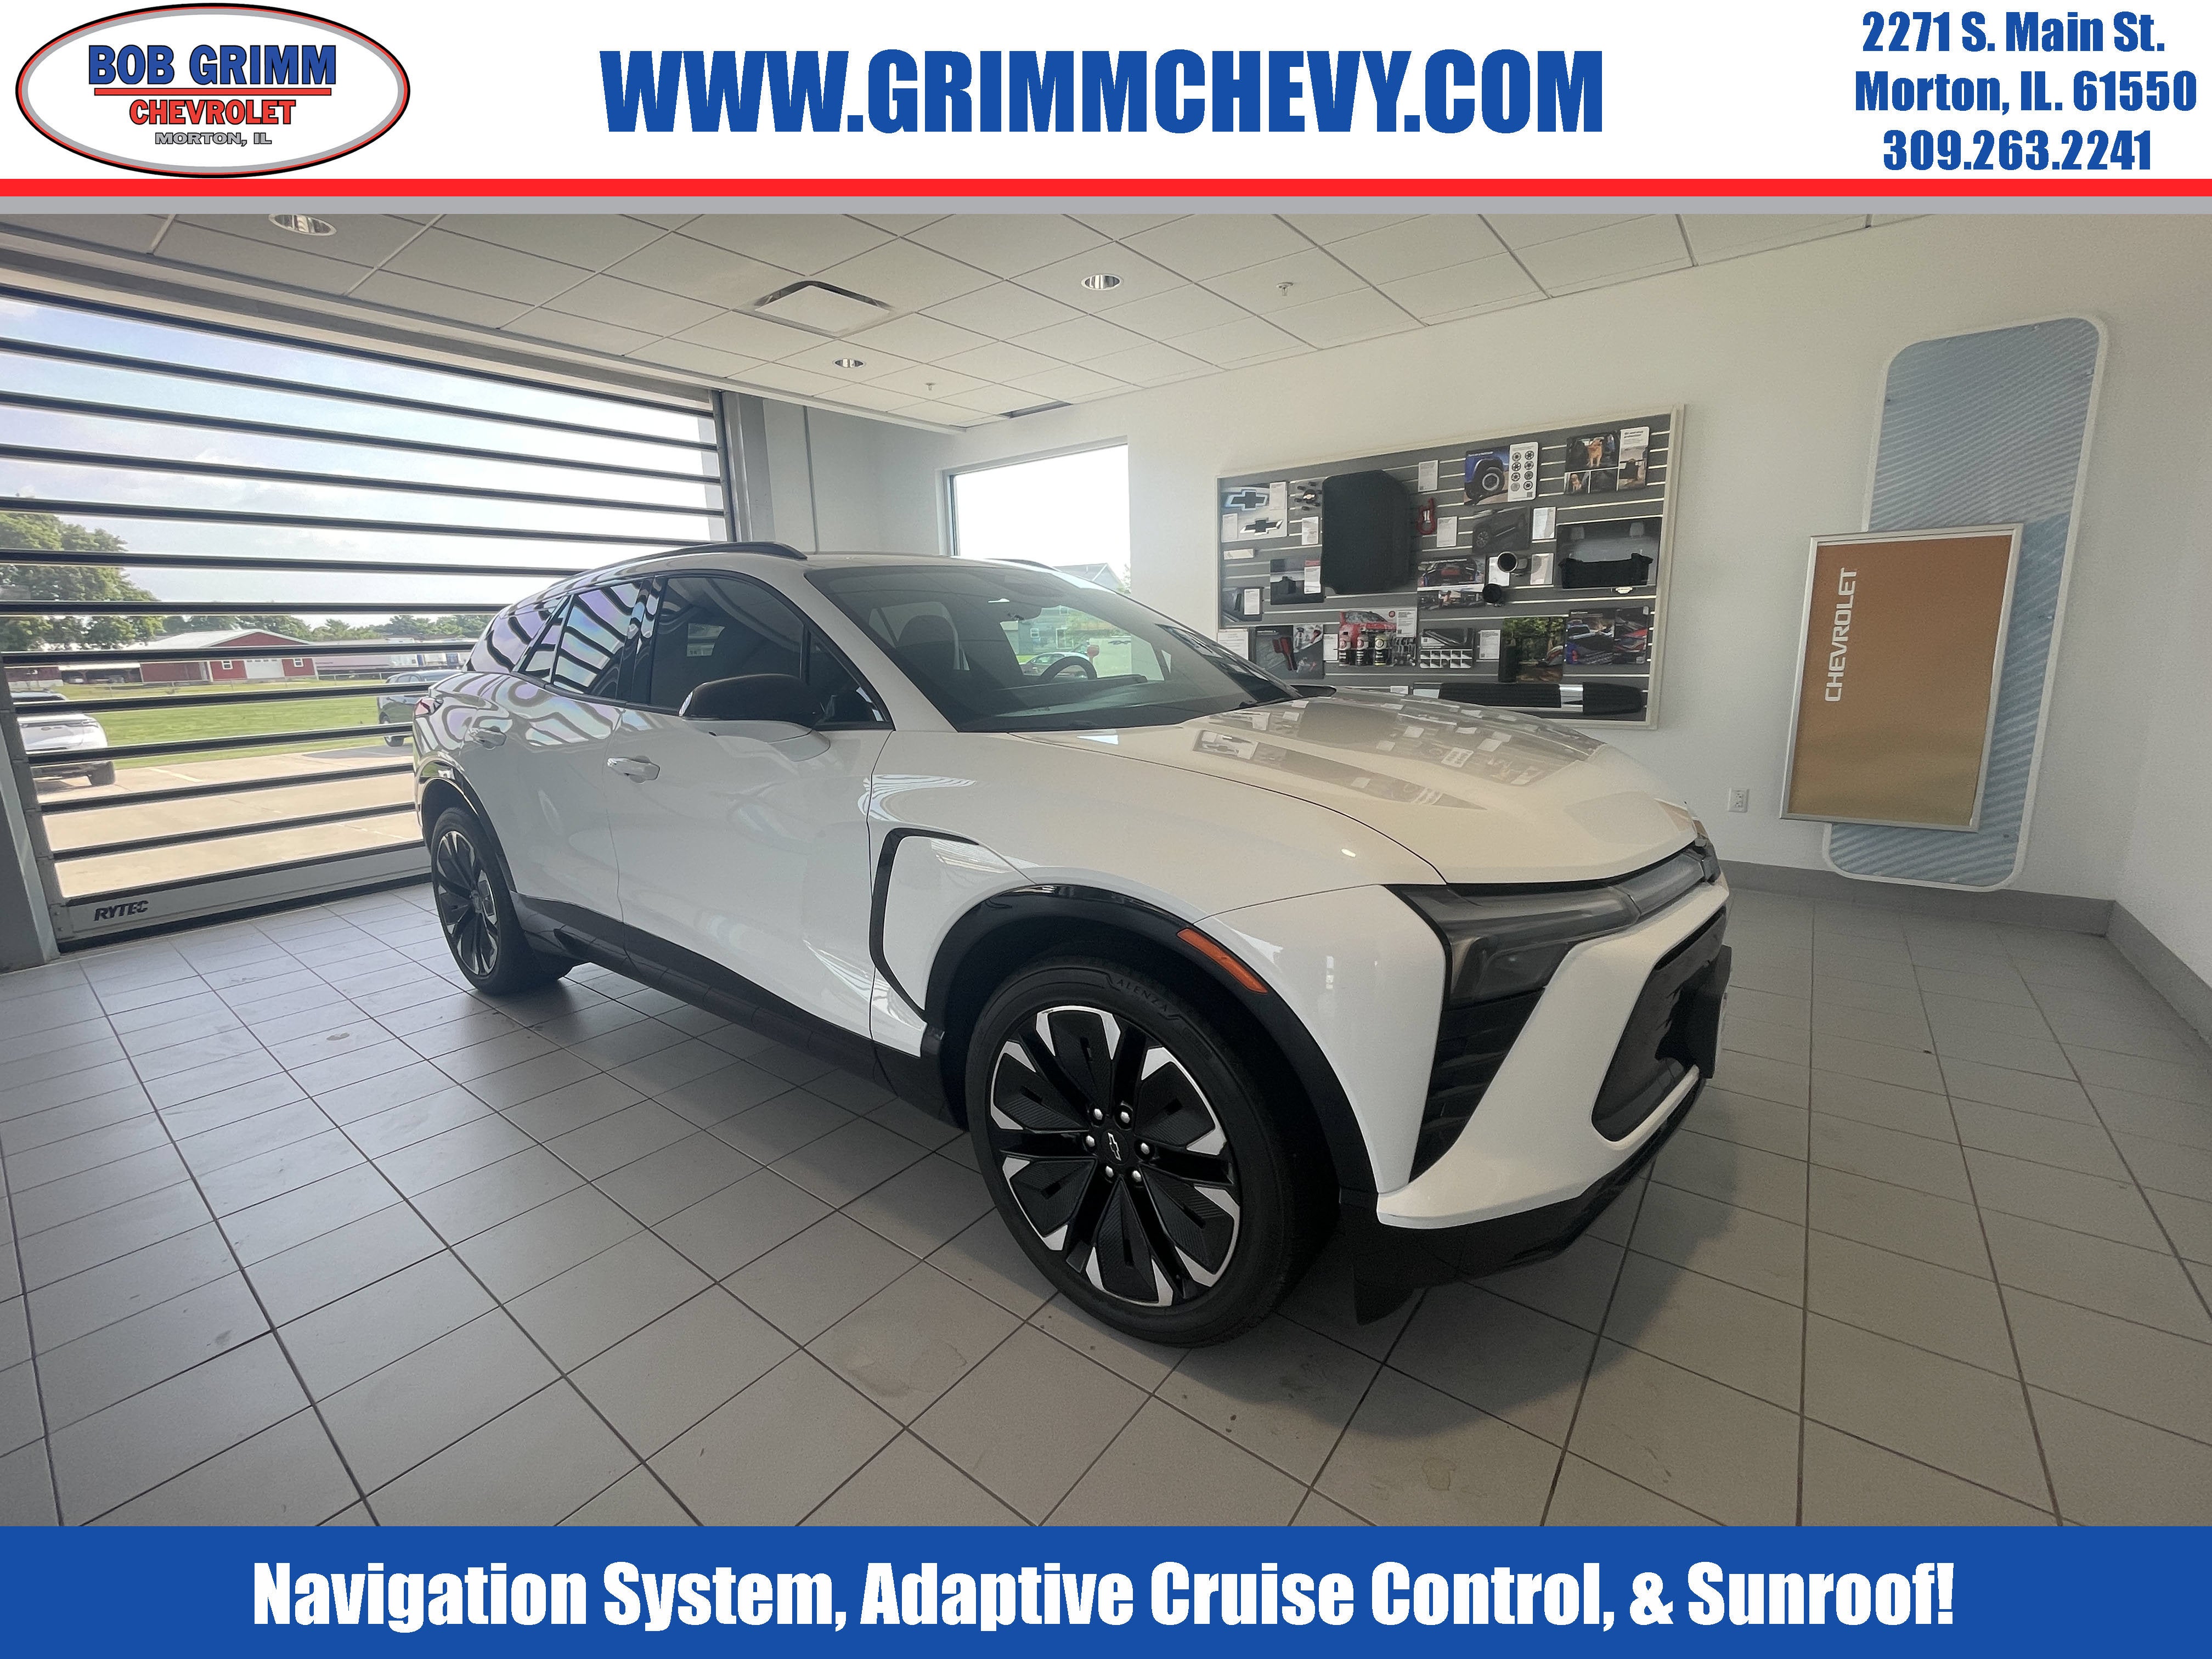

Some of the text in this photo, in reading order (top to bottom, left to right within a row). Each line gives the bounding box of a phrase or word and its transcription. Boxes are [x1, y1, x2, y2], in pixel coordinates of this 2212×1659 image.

[1825, 567, 1858, 702] CHEVROLET
[93, 900, 149, 921] RYTEC
[1116, 978, 1168, 1012] ALENZA
